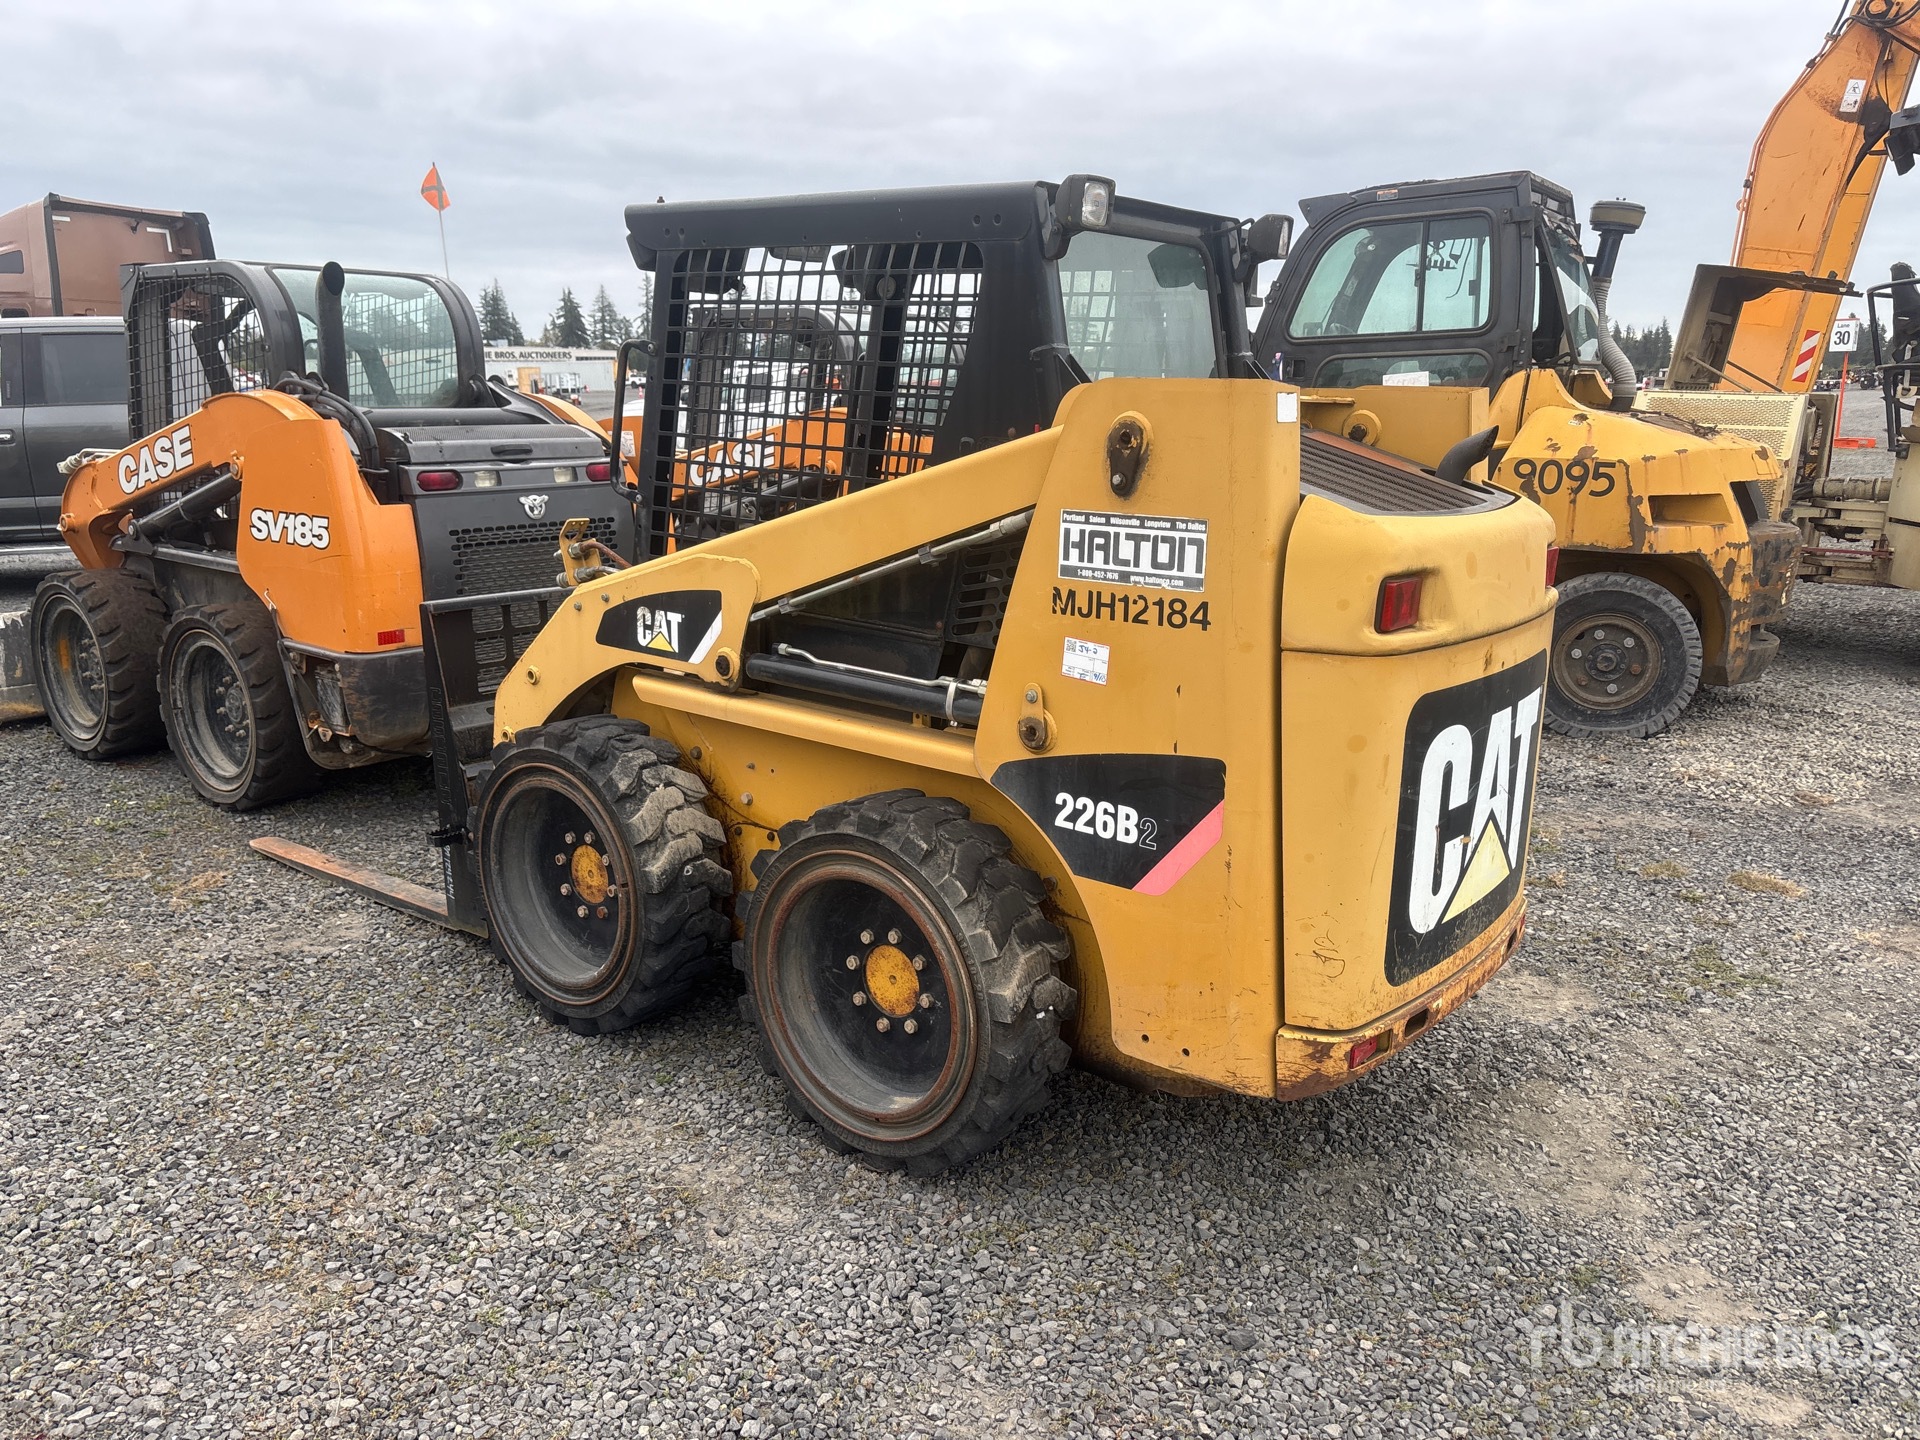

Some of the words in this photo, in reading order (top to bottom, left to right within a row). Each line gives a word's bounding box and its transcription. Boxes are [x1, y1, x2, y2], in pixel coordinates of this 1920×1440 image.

[495, 351, 518, 359] BROS.
[519, 351, 573, 360] AUCTIONEERS
[1834, 331, 1851, 346] 30
[118, 424, 194, 495] CASE
[690, 433, 775, 486] CASE
[1513, 458, 1617, 497] 9095
[250, 508, 330, 549] SV185
[1063, 513, 1086, 523] Portland
[1089, 515, 1106, 524] Salem
[1176, 521, 1187, 530] The
[1062, 527, 1205, 575] HALTON
[636, 606, 682, 653] CAT
[1052, 586, 1211, 631] MJH12184
[1409, 686, 1541, 934] CAT
